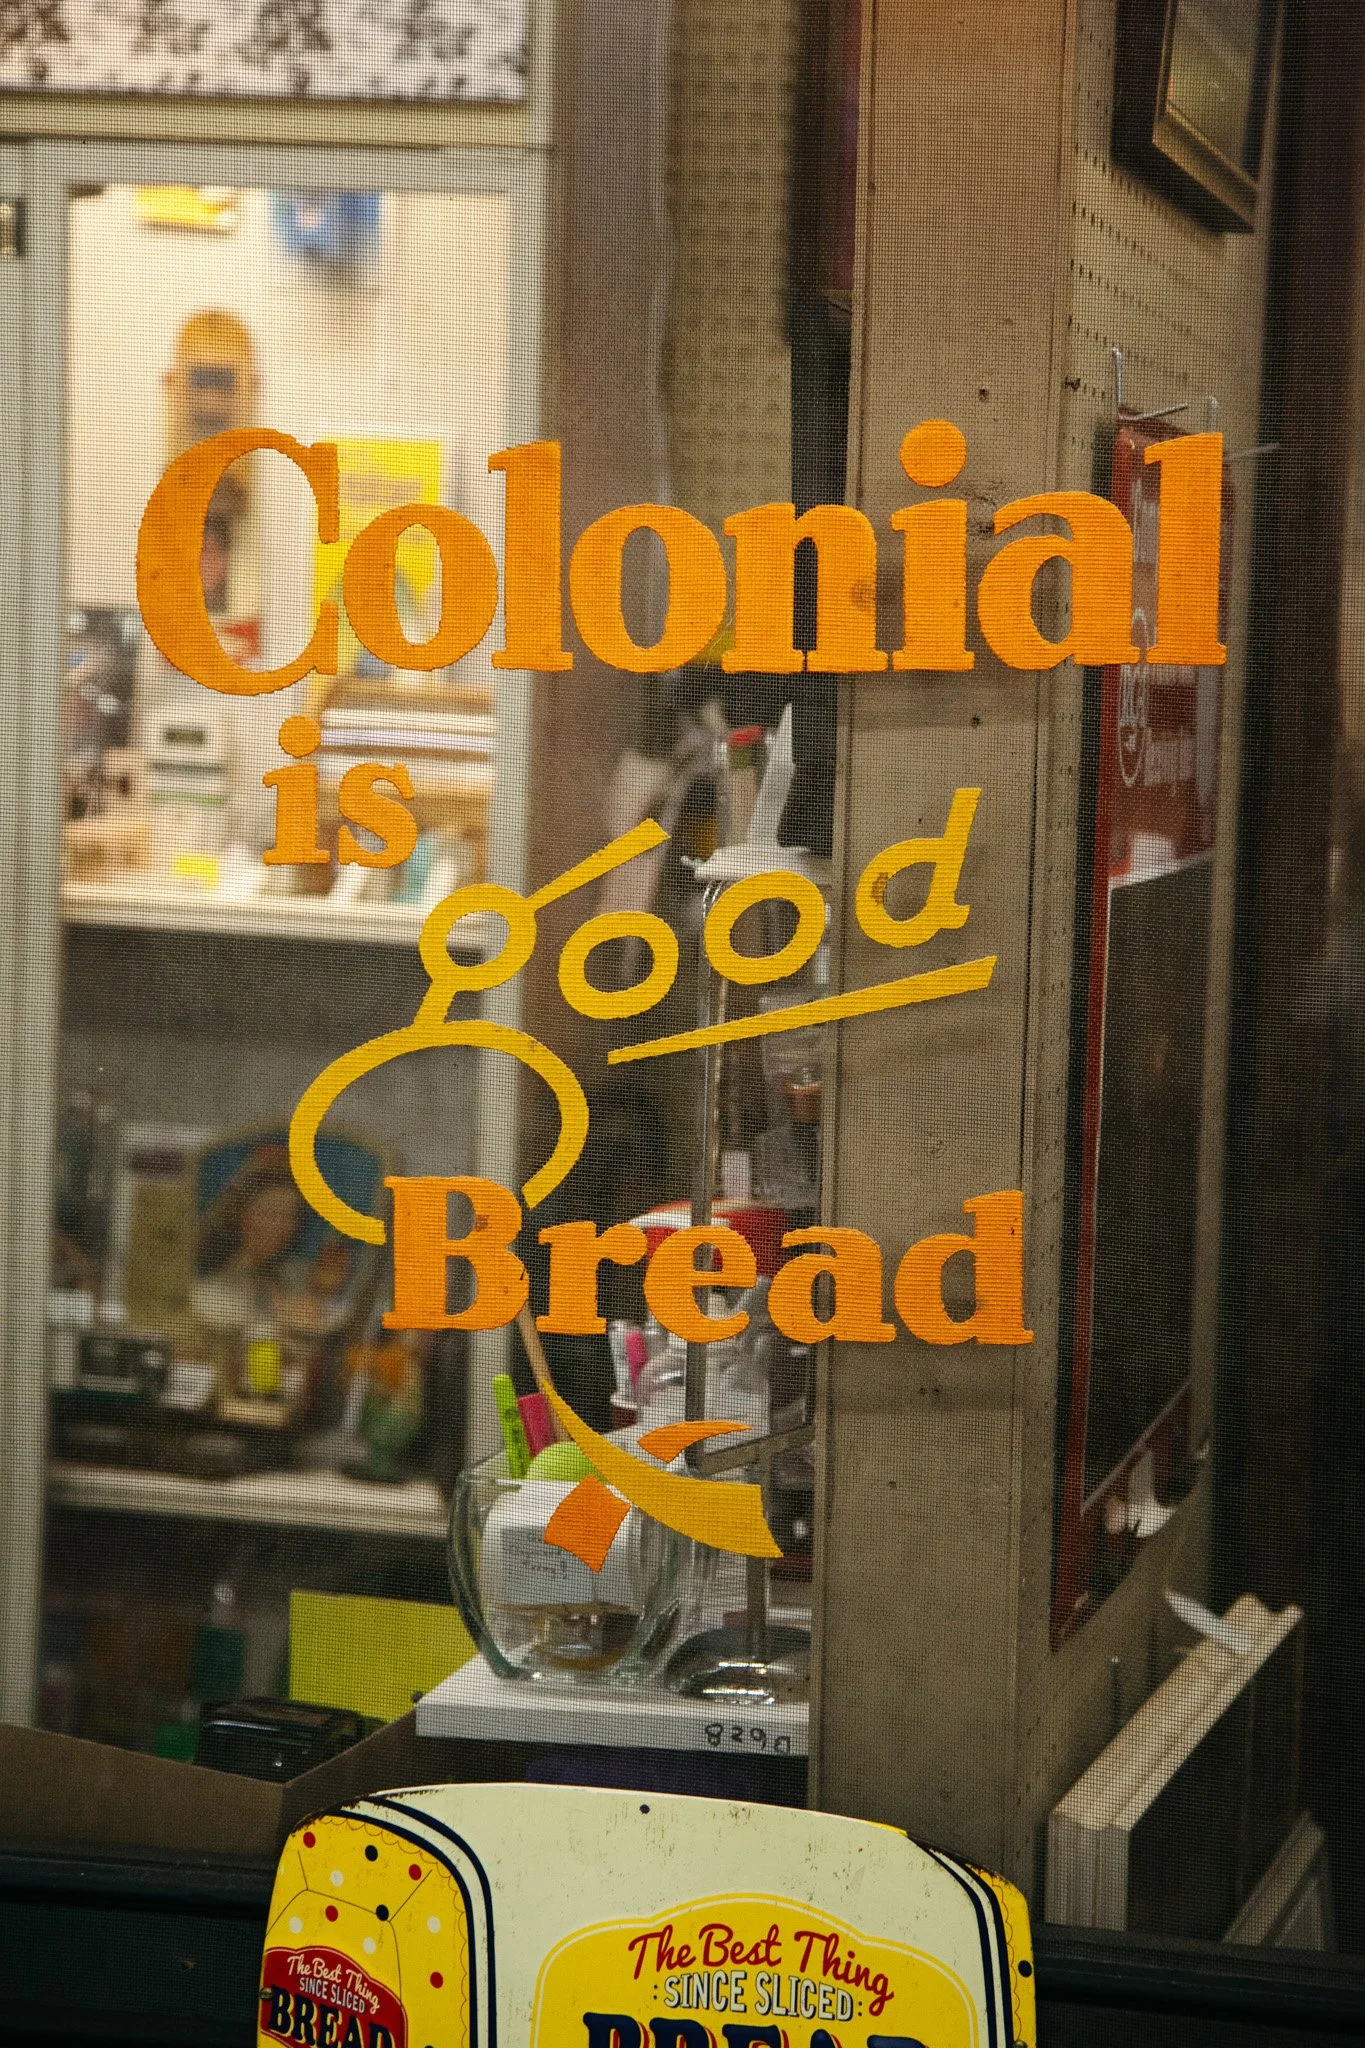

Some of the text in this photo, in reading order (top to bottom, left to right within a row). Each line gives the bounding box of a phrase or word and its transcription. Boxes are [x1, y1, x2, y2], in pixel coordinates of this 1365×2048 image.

[137, 419, 1228, 696] Colonial
[262, 715, 419, 869] is
[288, 786, 982, 1245] good
[382, 1175, 1035, 1345] Bread
[287, 1954, 380, 2015] The Best Thing
[299, 1977, 366, 2014] SINCE SLICED
[628, 1922, 895, 2017] The Best Thing
[663, 1970, 854, 2021] SINCE SLICED
